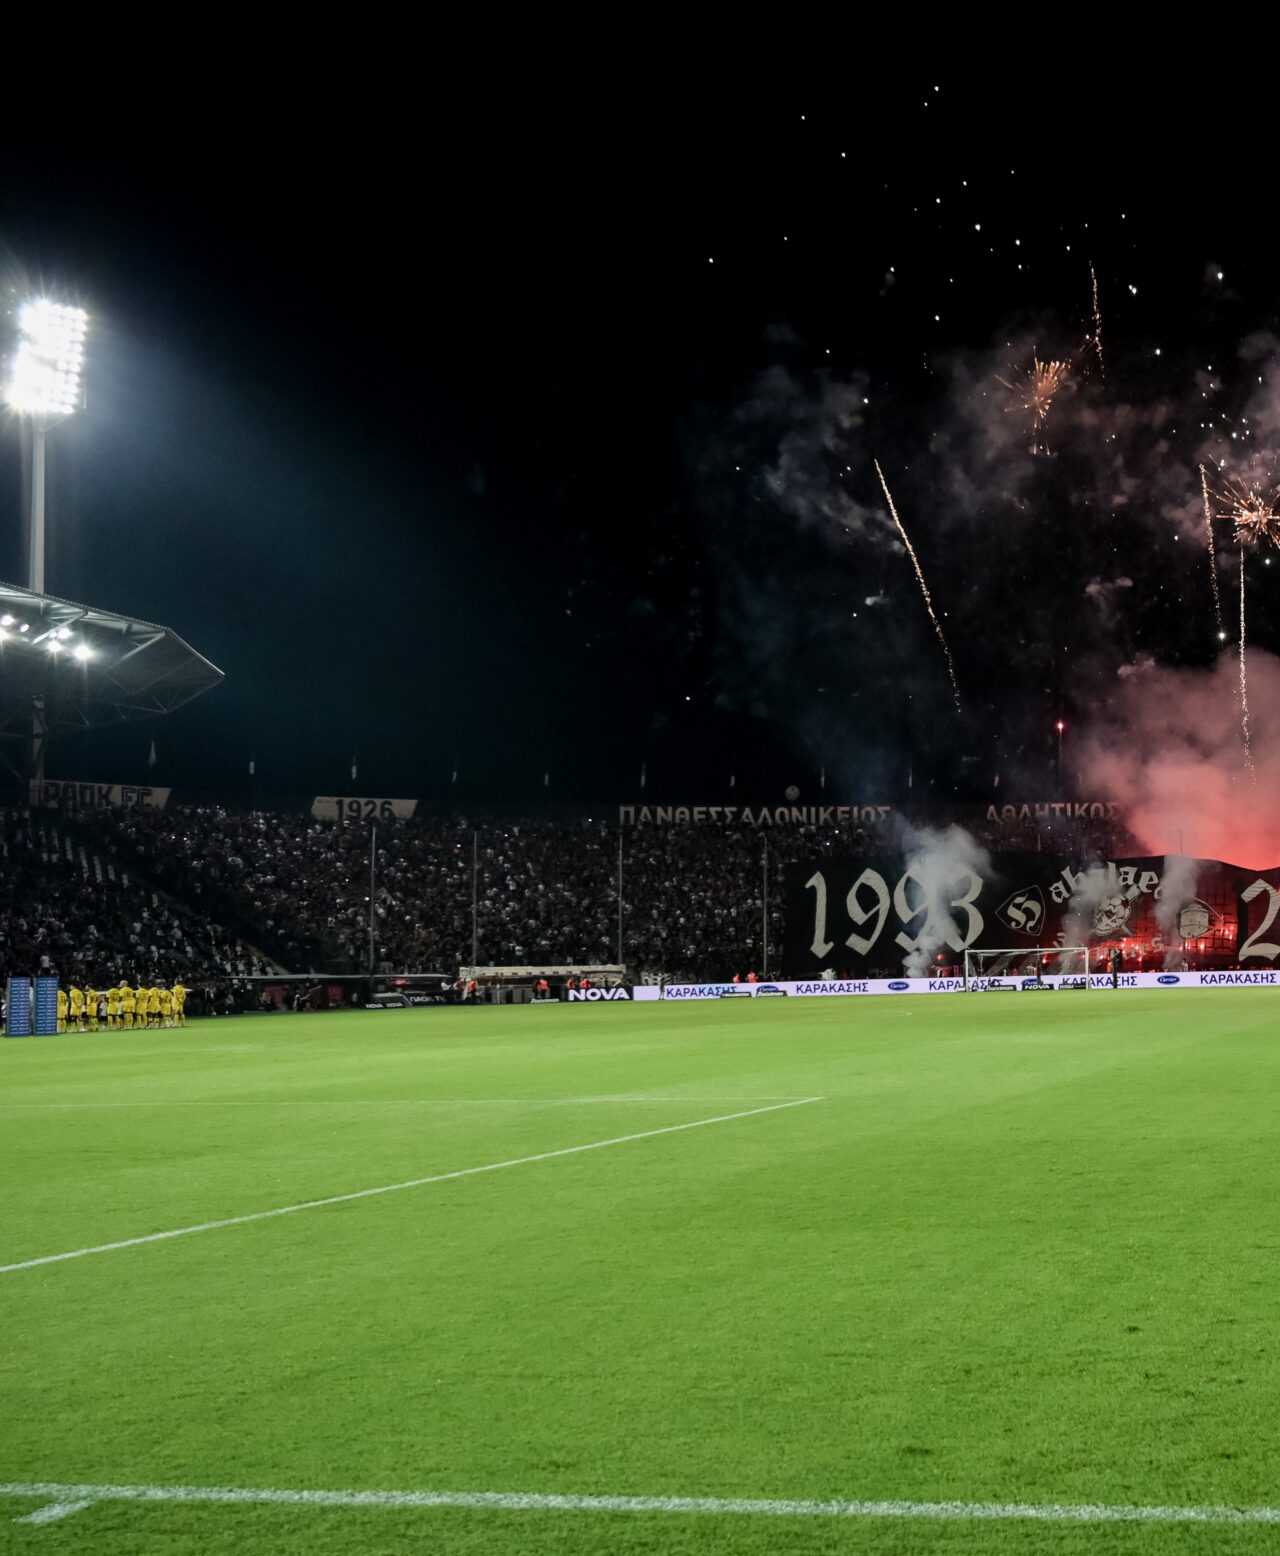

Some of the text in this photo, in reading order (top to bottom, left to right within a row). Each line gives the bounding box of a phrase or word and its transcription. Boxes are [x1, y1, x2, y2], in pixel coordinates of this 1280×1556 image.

[336, 799, 394, 820] 1926
[805, 866, 985, 959] 1993
[1200, 973, 1277, 984] ΚΑΡΑΚΑΣΗΣ
[568, 987, 630, 1001] NOVA
[796, 982, 869, 994] ΚΑΡΑΚΑΣΗΣ
